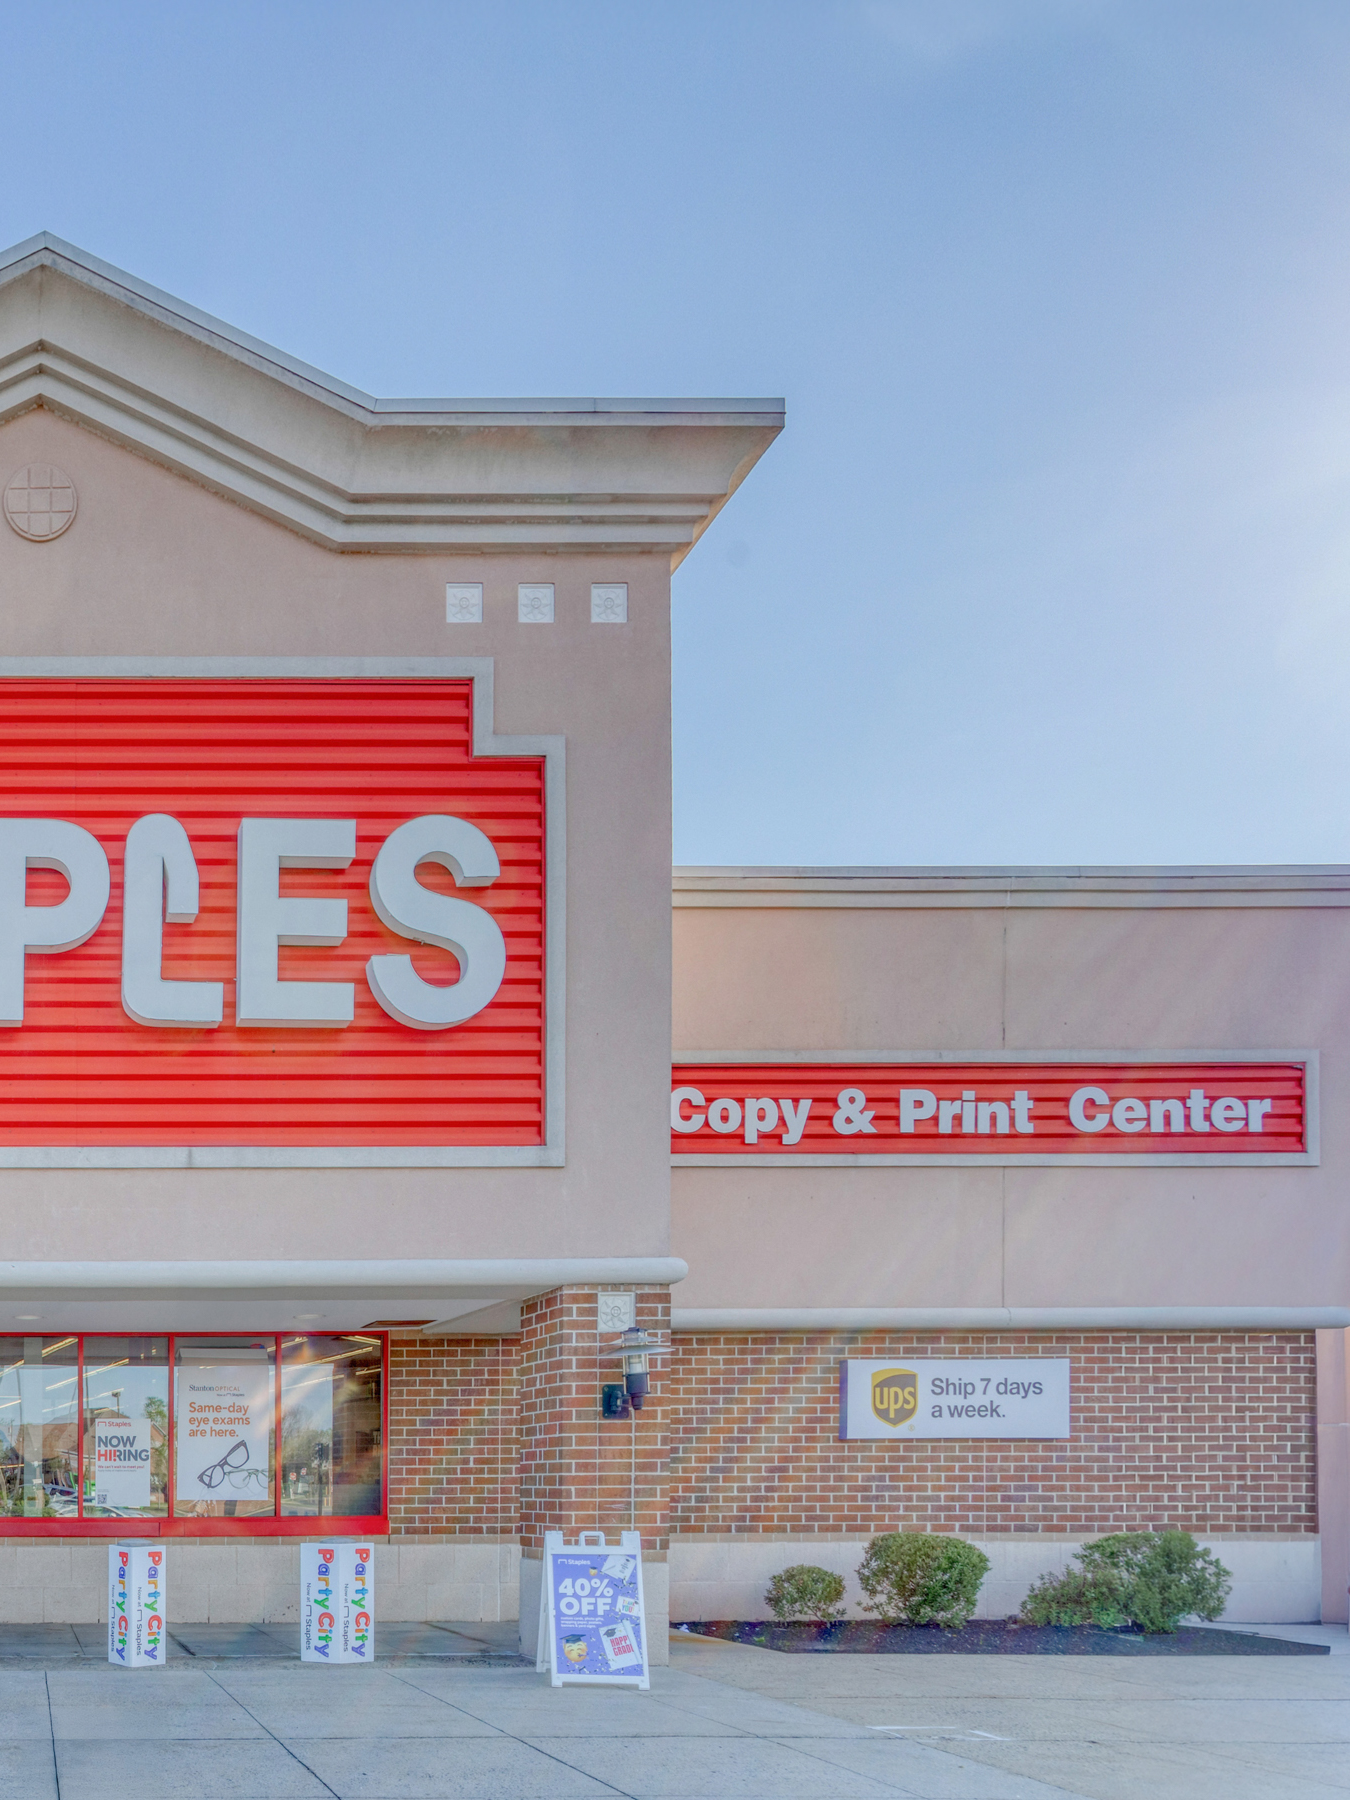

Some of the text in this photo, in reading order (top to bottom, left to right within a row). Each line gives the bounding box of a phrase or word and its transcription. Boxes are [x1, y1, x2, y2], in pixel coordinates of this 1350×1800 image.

[671, 1086, 1272, 1144] Copy & Print Center
[188, 1384, 215, 1392] Stanton
[931, 1377, 1043, 1399] Ship 7 days
[188, 1401, 250, 1416] Same-day
[875, 1386, 915, 1418] ups
[931, 1400, 1006, 1418] a week.
[188, 1416, 251, 1428] eye exams
[188, 1426, 239, 1438] are here.
[97, 1435, 137, 1448] NOW
[567, 1558, 591, 1566] Staples
[558, 1578, 614, 1597] 40%
[144, 1551, 163, 1660] Party City
[314, 1549, 335, 1658] Party City
[351, 1548, 370, 1657] Party City
[559, 1597, 612, 1615] OFF
[304, 1619, 312, 1650] Staples
